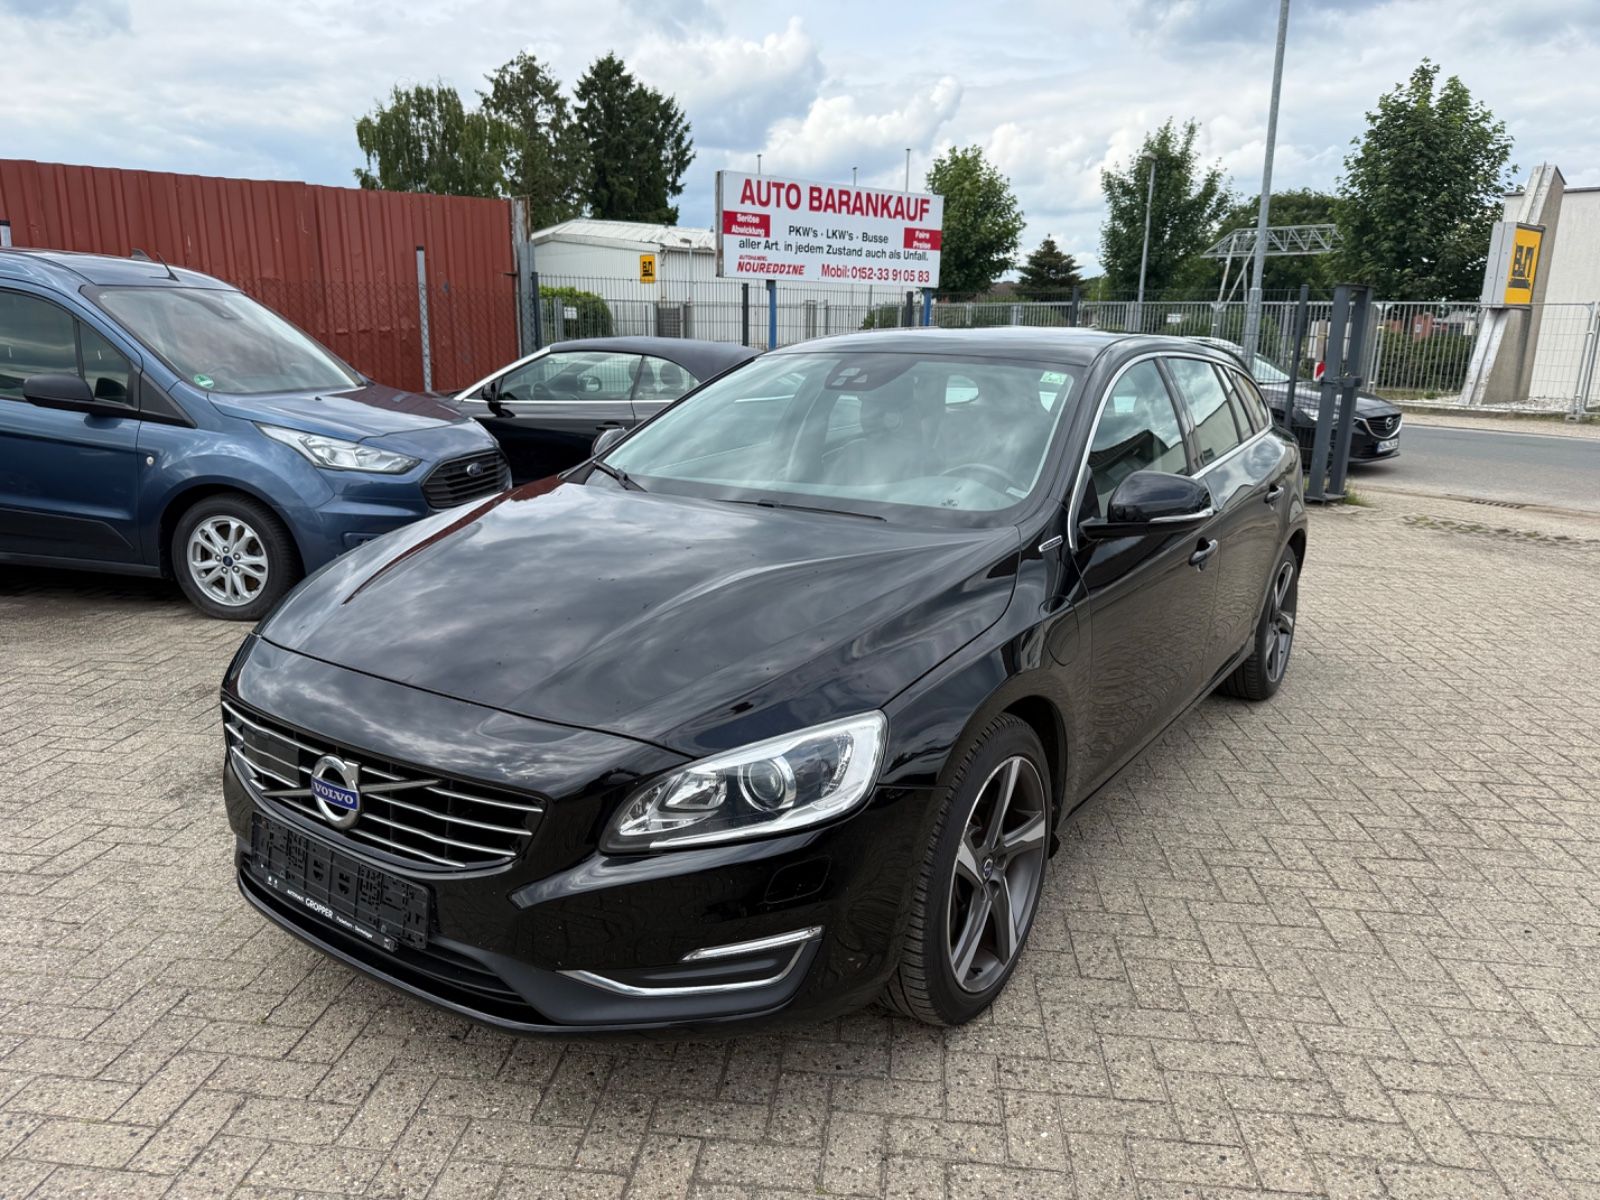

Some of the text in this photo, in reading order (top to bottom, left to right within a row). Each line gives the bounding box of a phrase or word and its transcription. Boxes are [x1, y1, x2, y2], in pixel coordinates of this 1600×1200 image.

[740, 178, 930, 222] AUTO BARANKAUF
[737, 214, 760, 224] Seriöse
[731, 225, 765, 237] Abwicklung
[788, 225, 888, 243] PKW's LKW's Busse
[739, 238, 761, 249] aller
[784, 241, 792, 251] in
[795, 242, 824, 254] jedem
[826, 245, 862, 256] Zustand
[865, 249, 886, 259] auch
[889, 250, 901, 259] als
[903, 250, 928, 261] Unfall.
[737, 261, 805, 275] NOUREDDINE
[822, 264, 849, 278] Mobil:
[918, 271, 930, 282] 83
[314, 782, 354, 804] VOLVO
